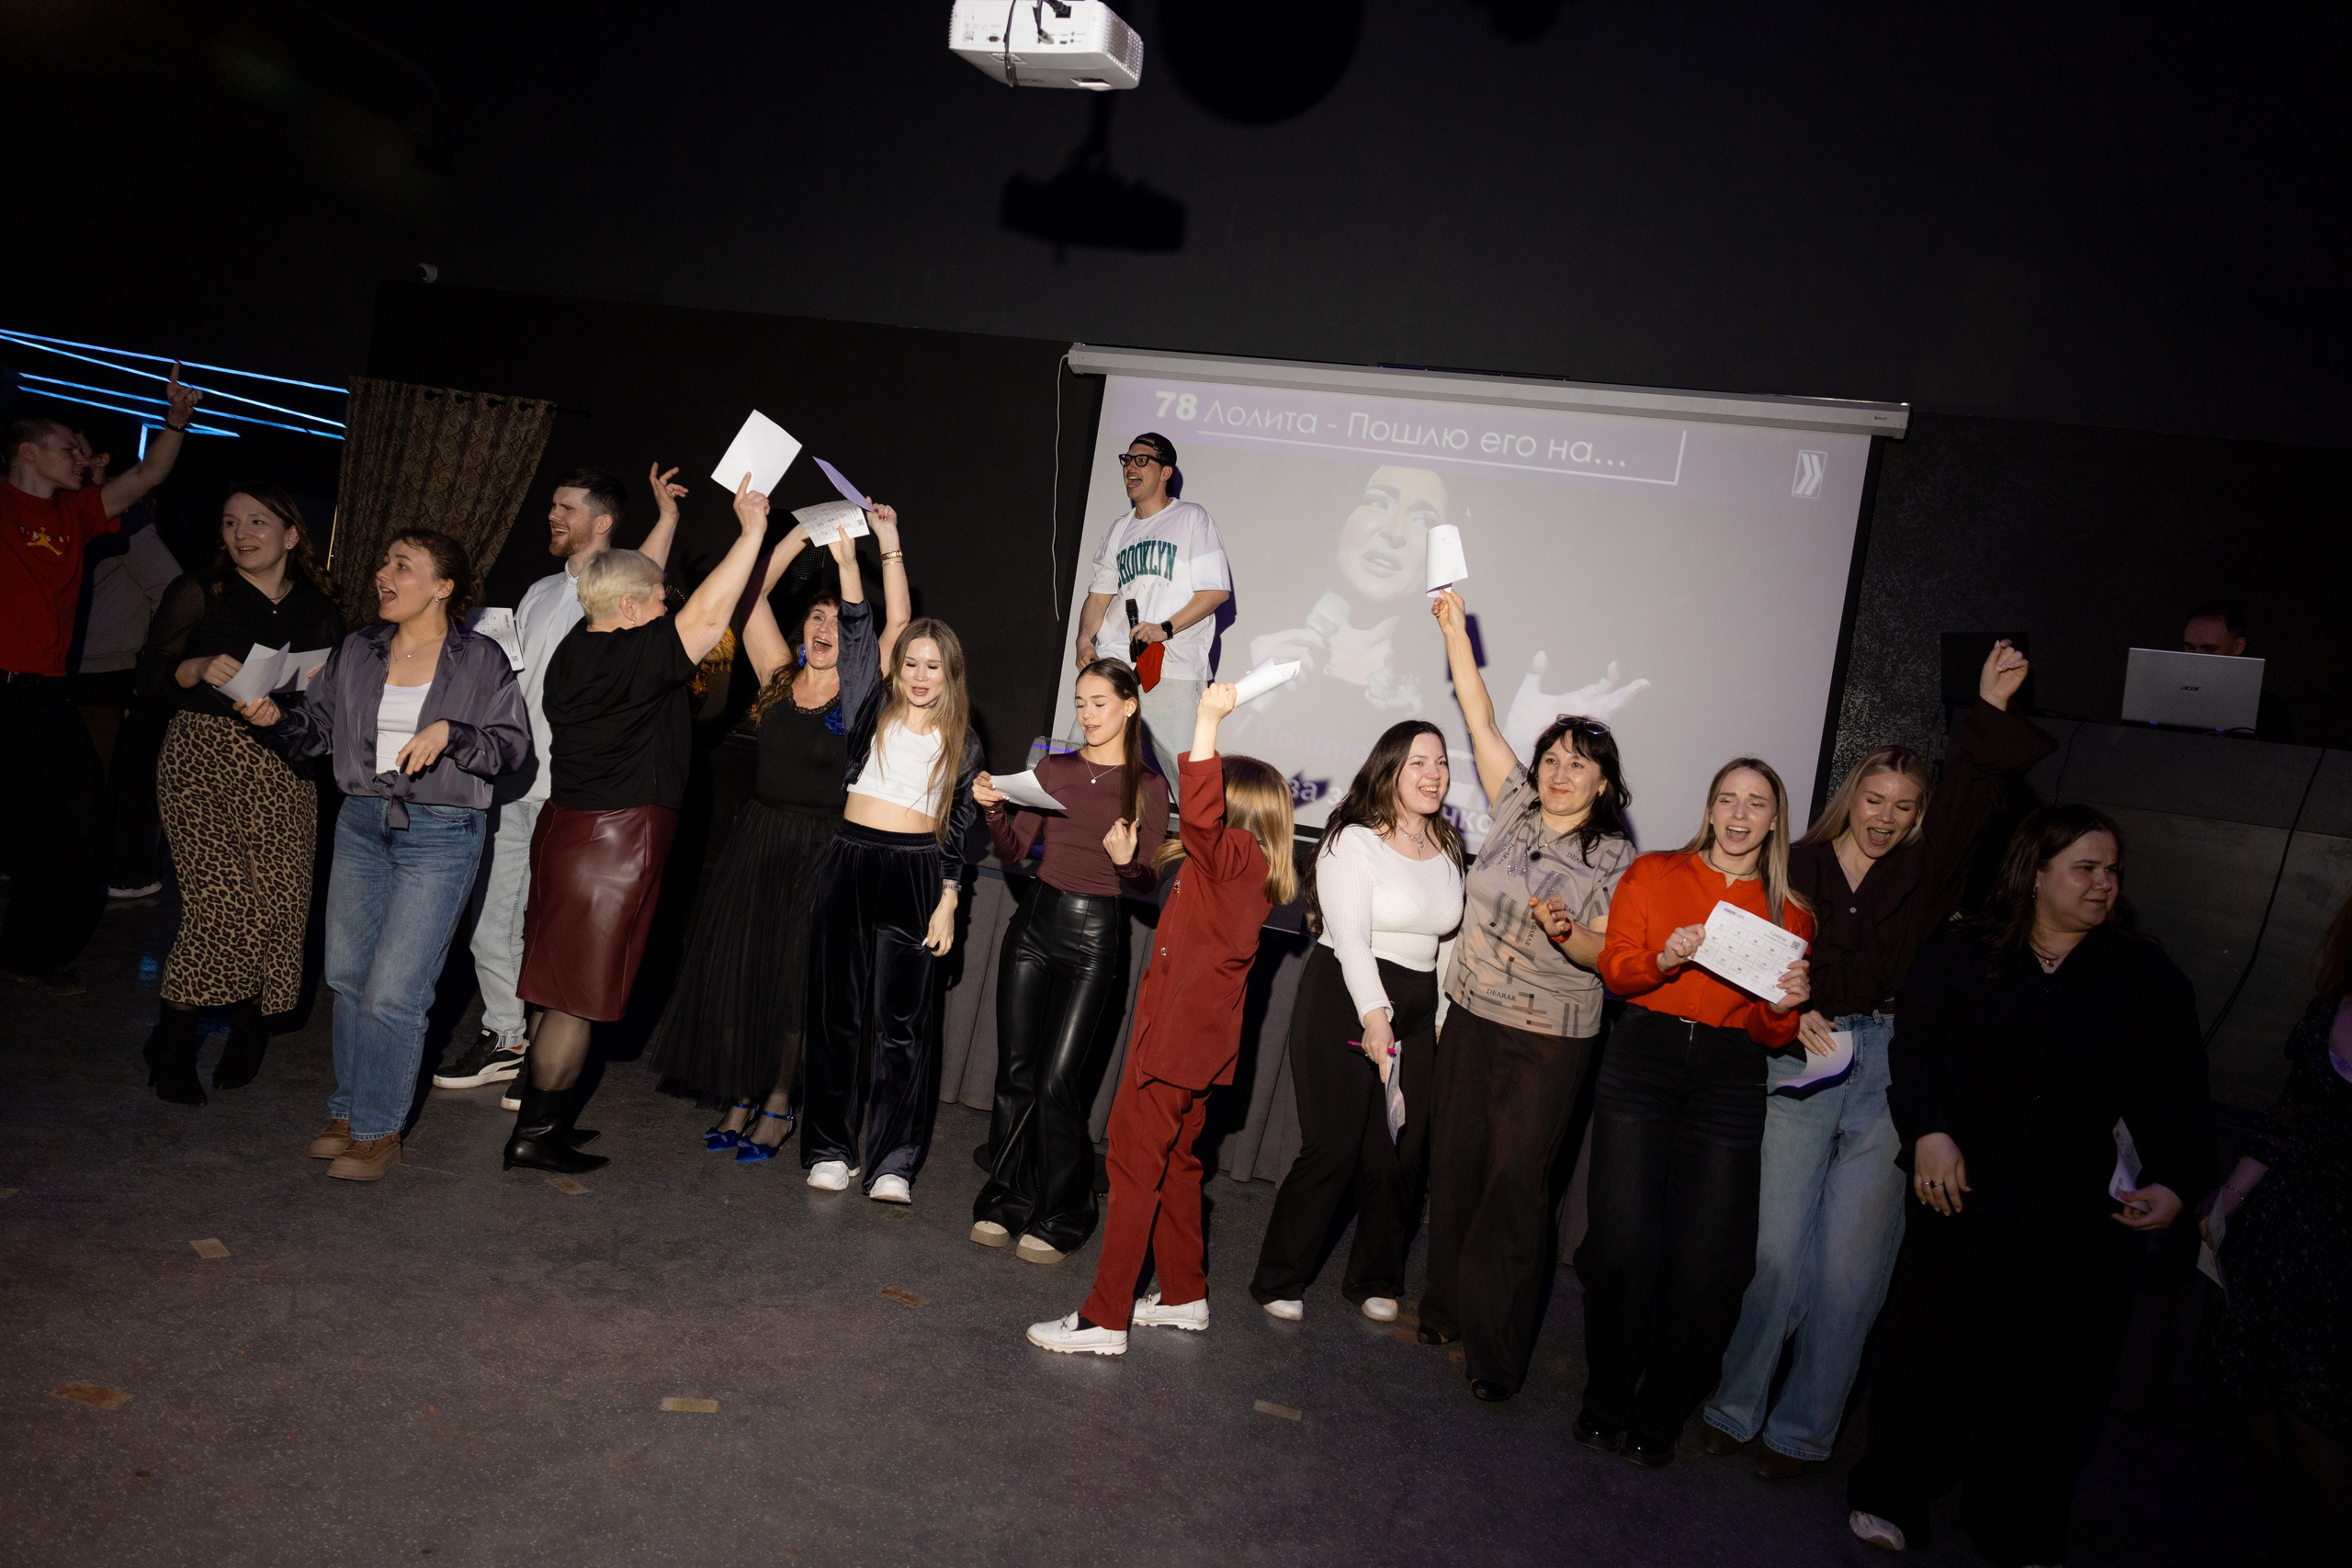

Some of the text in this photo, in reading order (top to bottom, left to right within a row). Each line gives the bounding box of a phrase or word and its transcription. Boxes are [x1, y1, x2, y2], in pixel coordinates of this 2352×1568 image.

[1156, 390, 1198, 421] 78
[1204, 399, 1318, 434] Лолита
[1347, 412, 1469, 450] Пошлю
[1480, 432, 1537, 457] его
[1548, 438, 1626, 468] на...
[1486, 987, 1517, 1001] DEARAR
